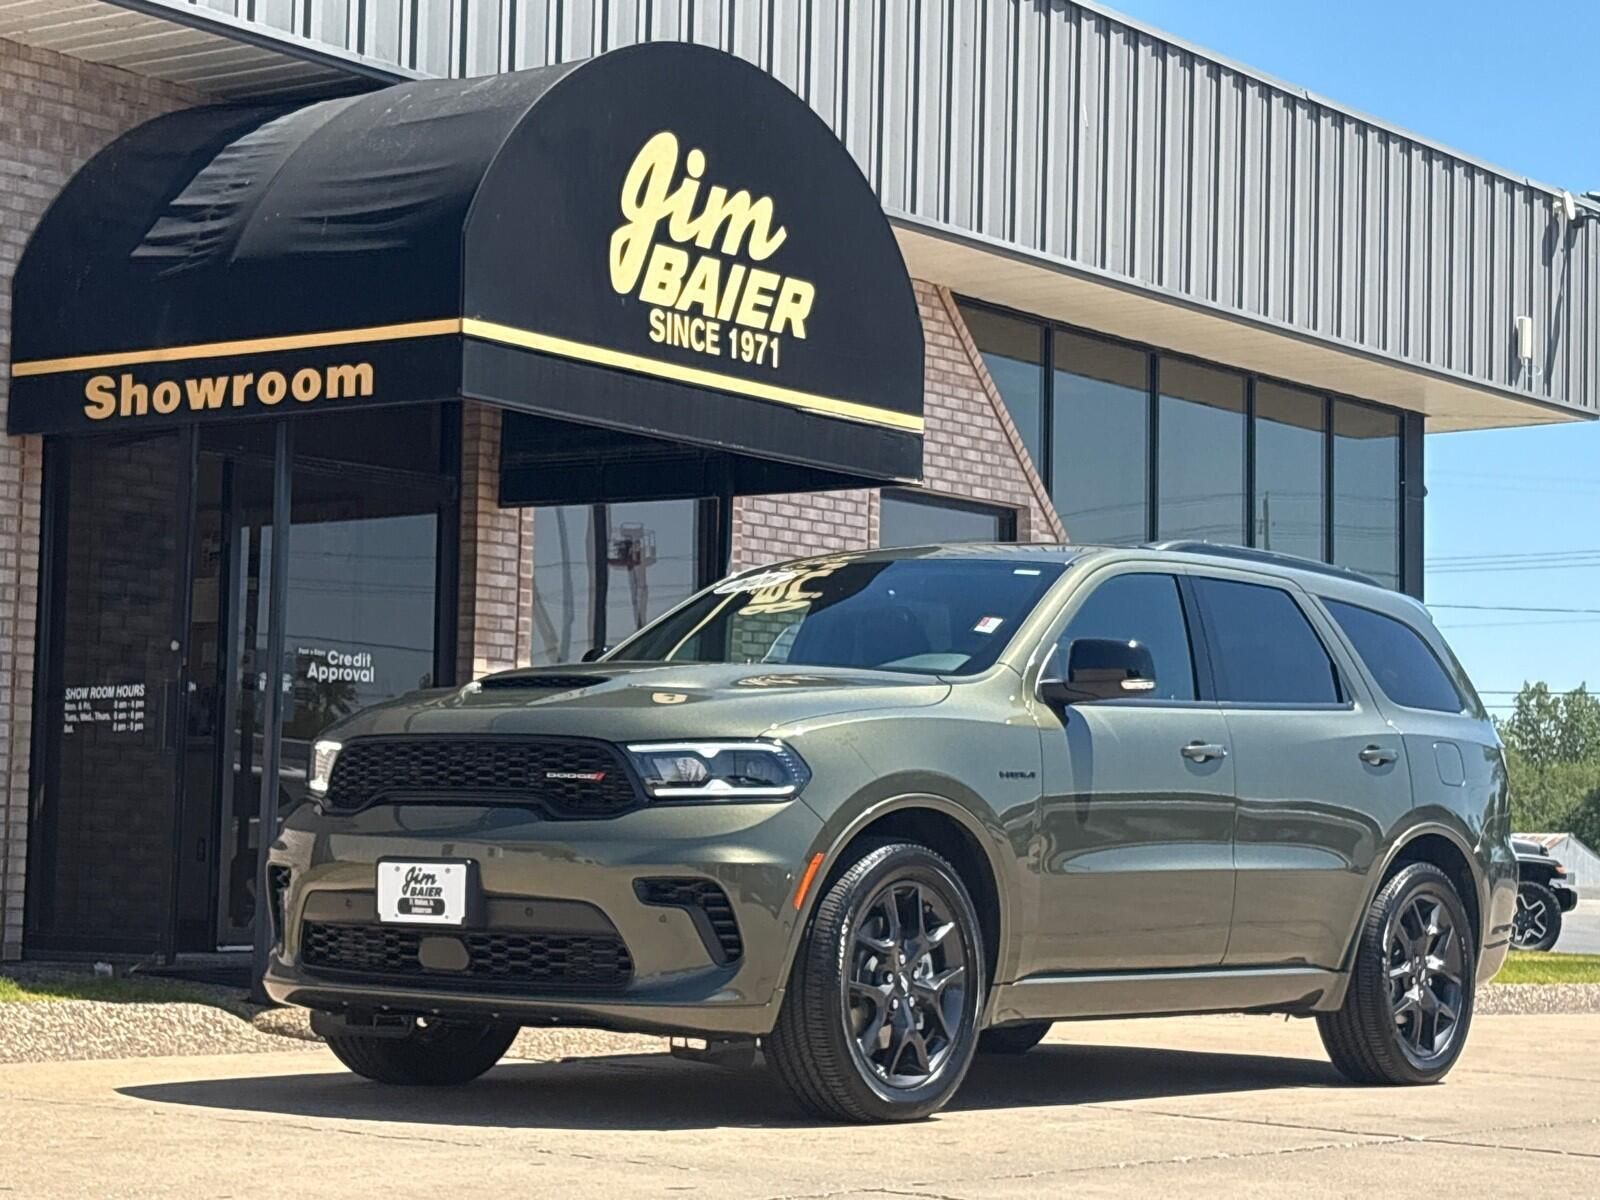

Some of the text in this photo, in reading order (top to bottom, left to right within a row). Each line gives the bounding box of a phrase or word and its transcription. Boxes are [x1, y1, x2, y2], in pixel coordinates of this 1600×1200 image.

[609, 131, 787, 295] Jim
[638, 243, 815, 339] BAIER
[649, 308, 779, 369] SINCE 1971
[84, 362, 374, 419] Showroom
[307, 661, 374, 683] Approval
[327, 650, 372, 668] Credit
[65, 683, 145, 700] SHOW ROOM HOURS
[402, 866, 437, 896] Jim
[410, 886, 443, 897] BAIER
